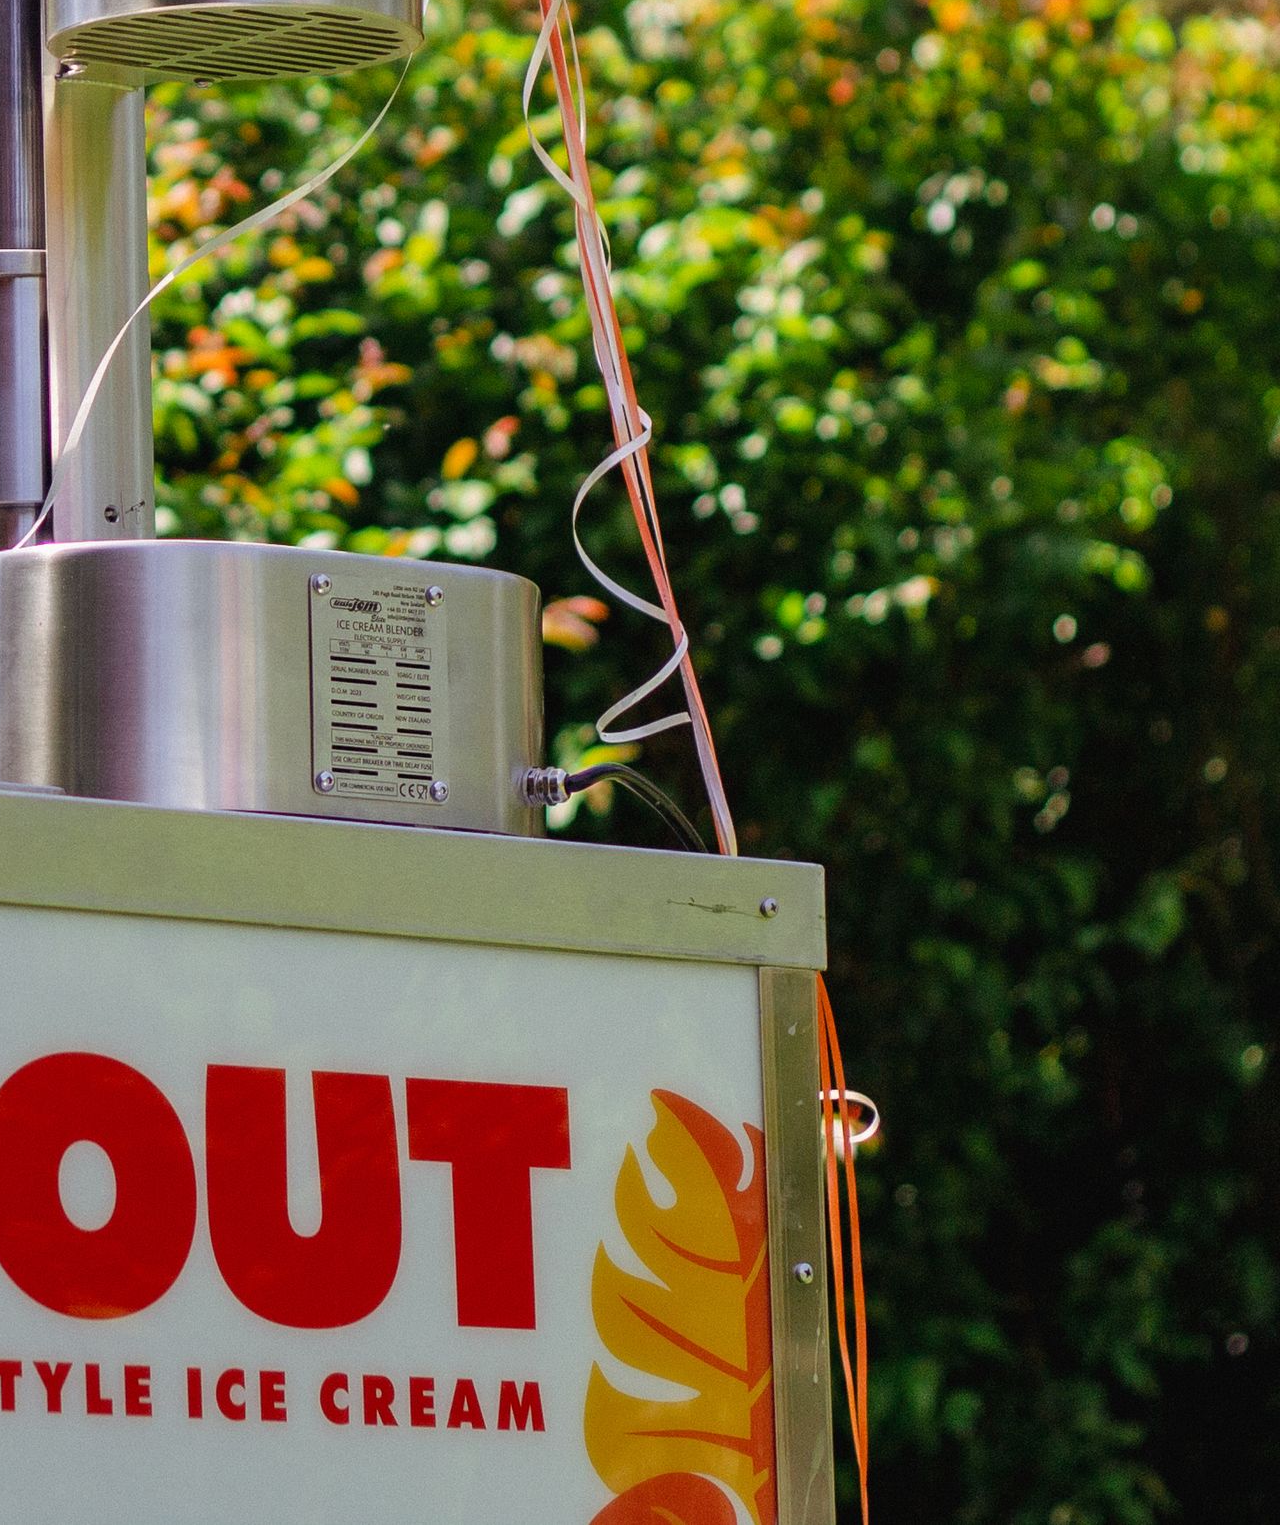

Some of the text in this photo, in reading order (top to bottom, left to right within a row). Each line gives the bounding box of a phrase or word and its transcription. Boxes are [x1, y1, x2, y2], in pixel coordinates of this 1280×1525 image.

[336, 620, 424, 637] ICE CREAM BLENDER
[354, 634, 406, 645] ELECTRICAL SUPPLY
[332, 710, 356, 718] COUNTRY
[408, 716, 431, 724] ZEALAND
[186, 1367, 289, 1424] ICE
[319, 1370, 547, 1433] CREAM
